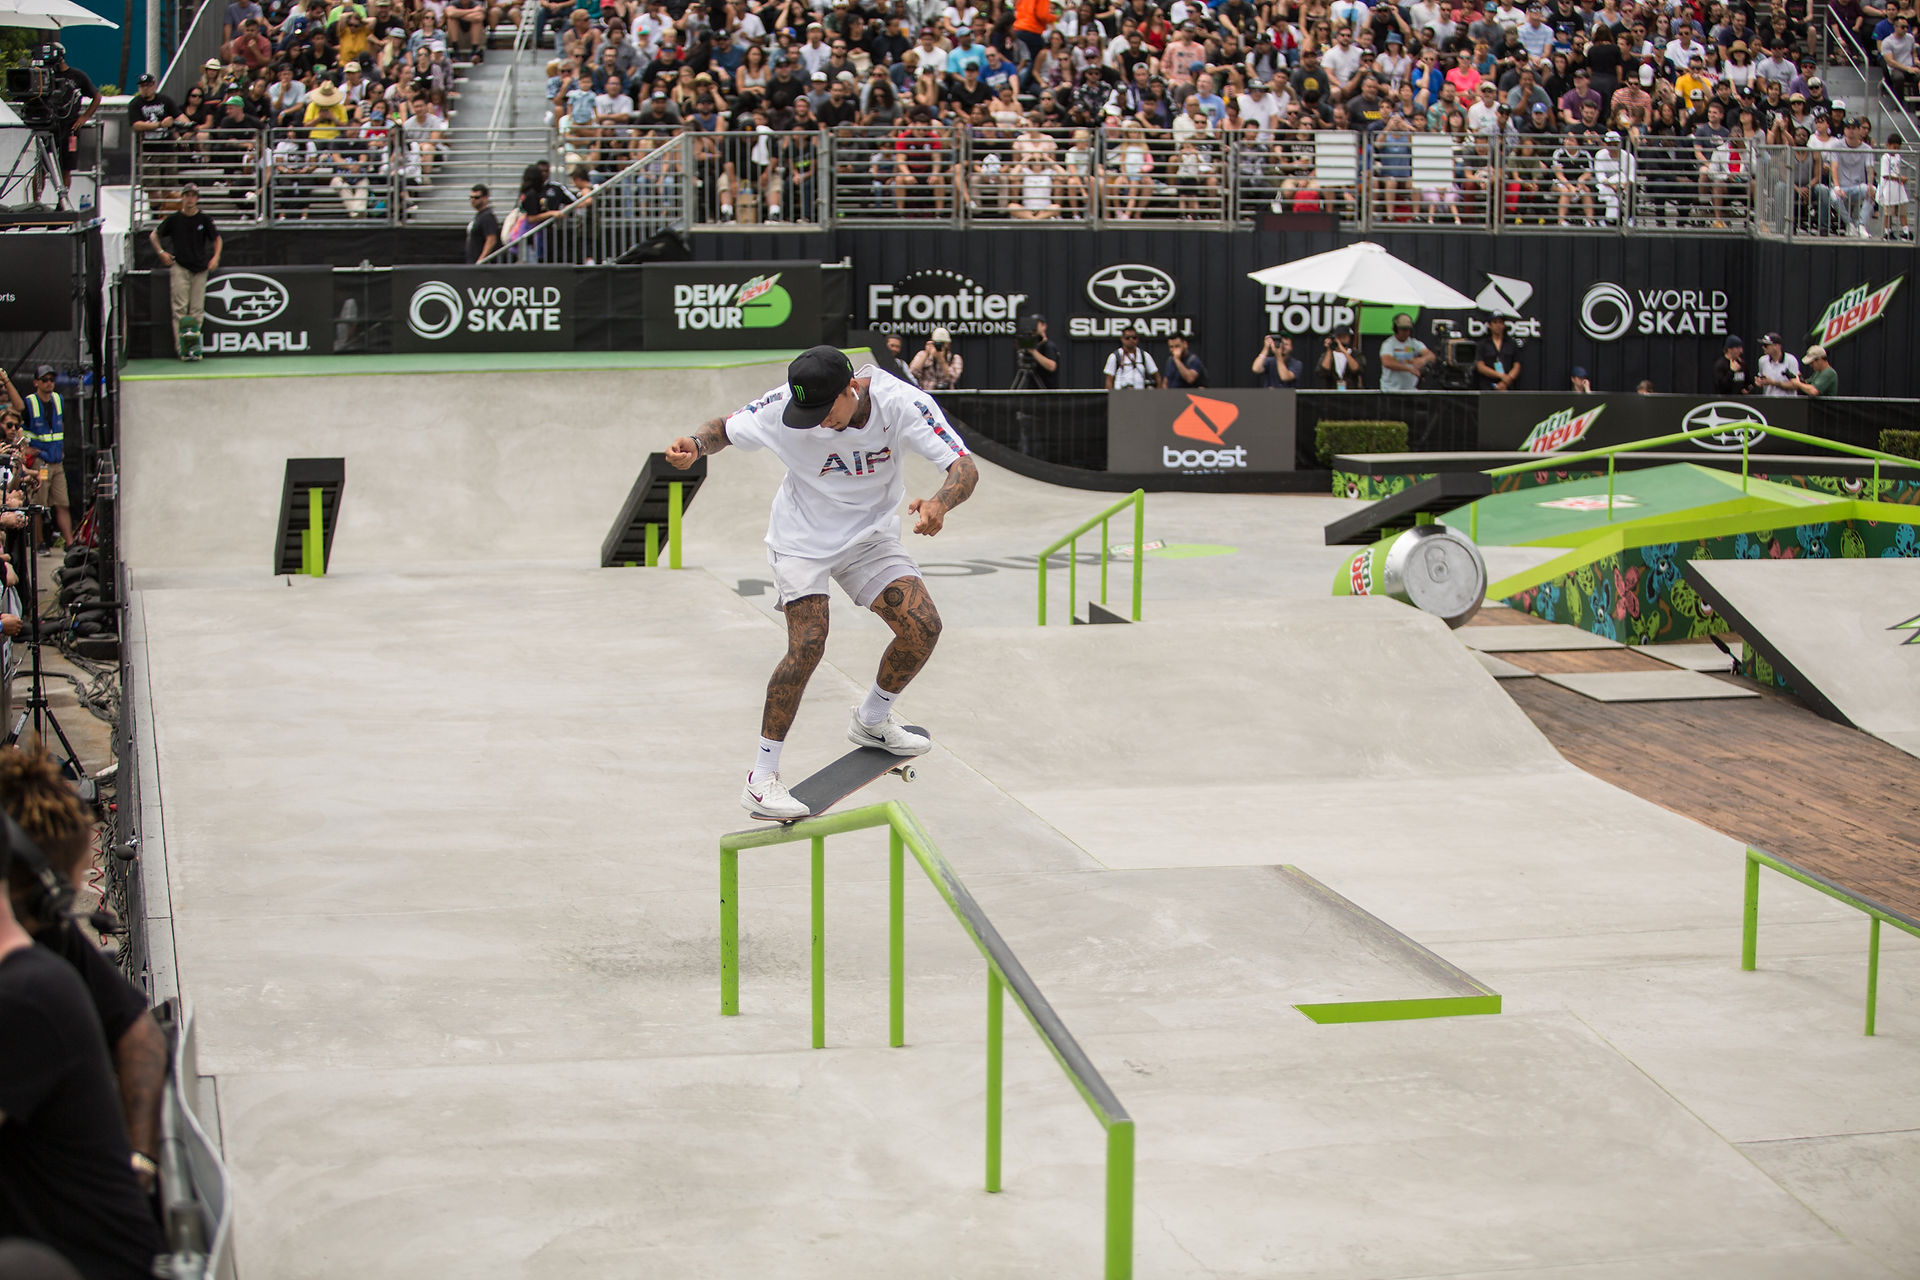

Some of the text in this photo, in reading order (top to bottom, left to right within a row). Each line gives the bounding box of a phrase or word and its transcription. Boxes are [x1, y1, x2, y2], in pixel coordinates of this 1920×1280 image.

[467, 287, 561, 307] WORLD
[674, 284, 738, 306] DEW
[869, 284, 1026, 320] Frontier
[1638, 289, 1728, 310] WORLD
[467, 308, 561, 332] SKATE
[674, 307, 743, 329] TOUR
[1637, 311, 1728, 334] SKATE
[200, 331, 308, 352] UBARU
[1163, 445, 1247, 467] boost
